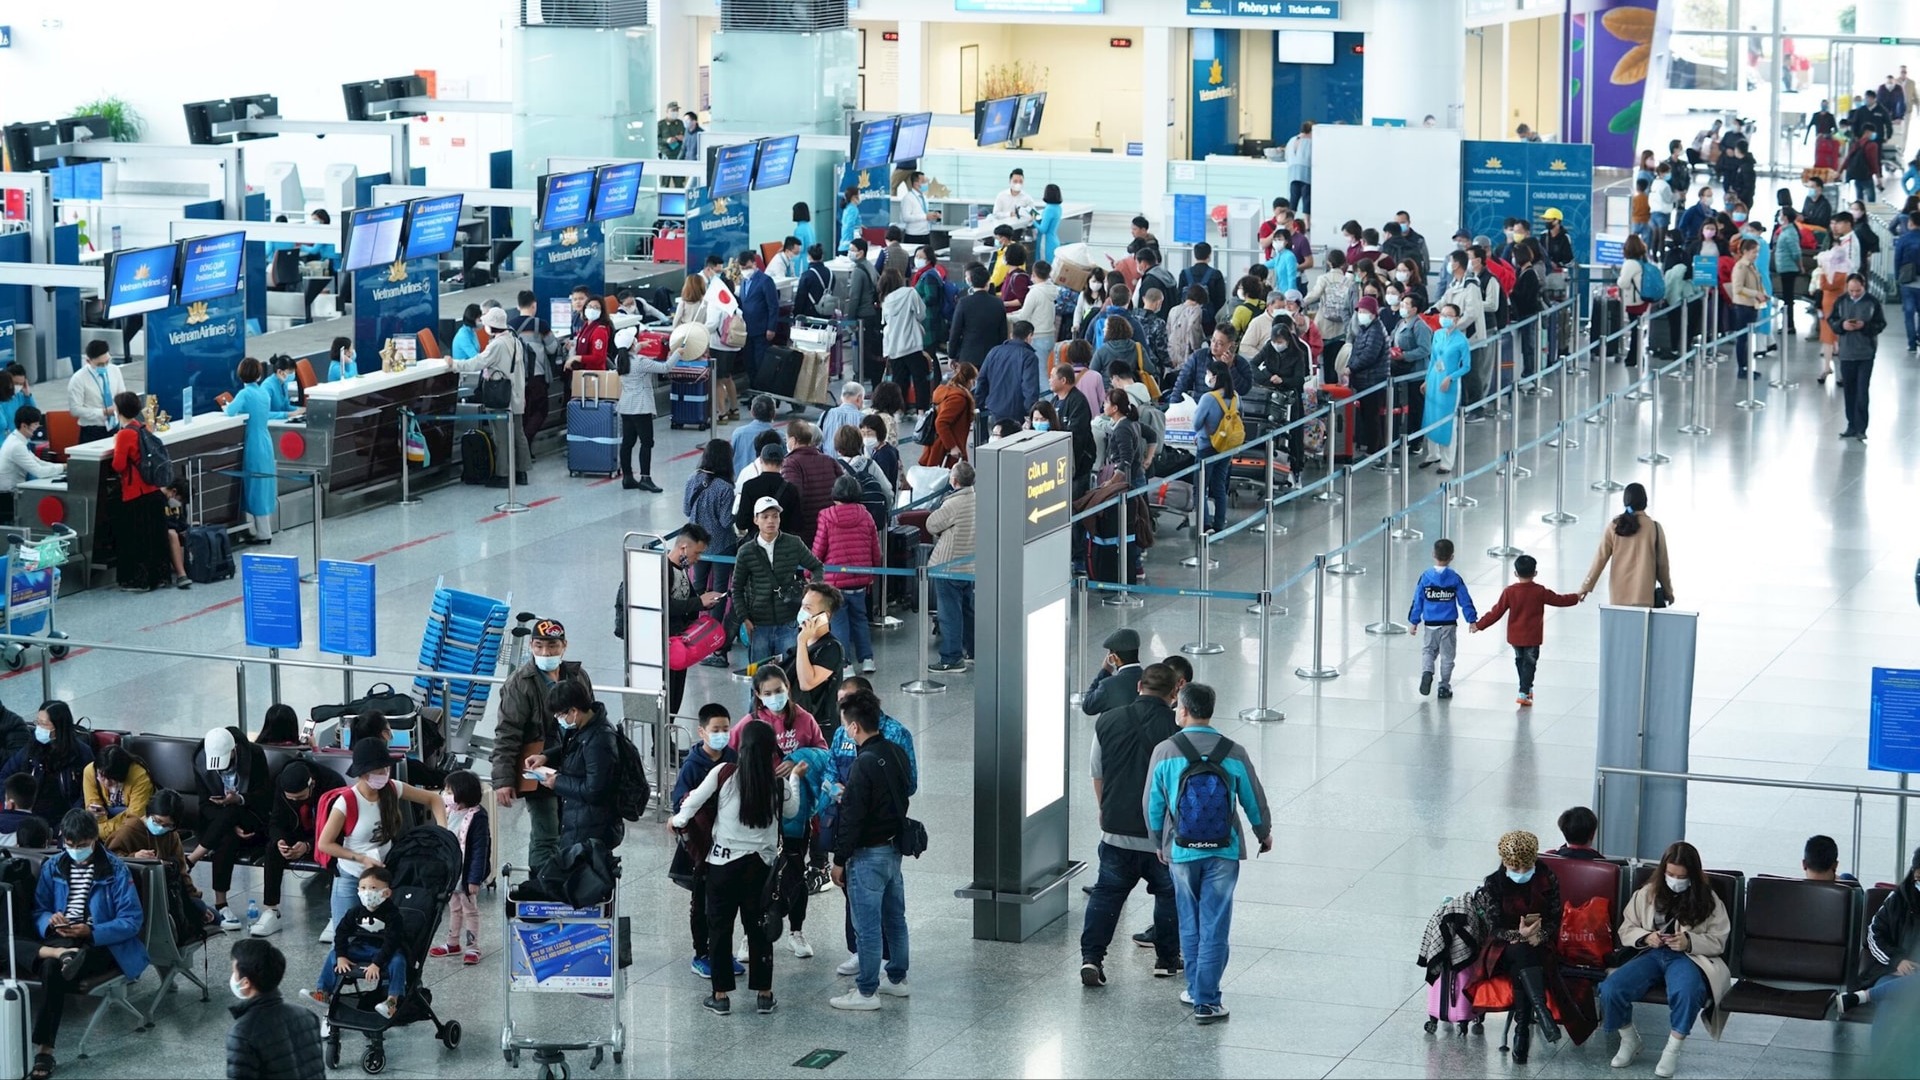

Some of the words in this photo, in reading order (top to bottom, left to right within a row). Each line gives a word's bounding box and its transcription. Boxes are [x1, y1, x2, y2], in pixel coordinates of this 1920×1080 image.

[1238, 2, 1268, 15] Phòng
[1270, 3, 1281, 14] vé
[1288, 5, 1310, 14] Ticket
[1311, 6, 1331, 15] office
[1028, 479, 1055, 499] Departure
